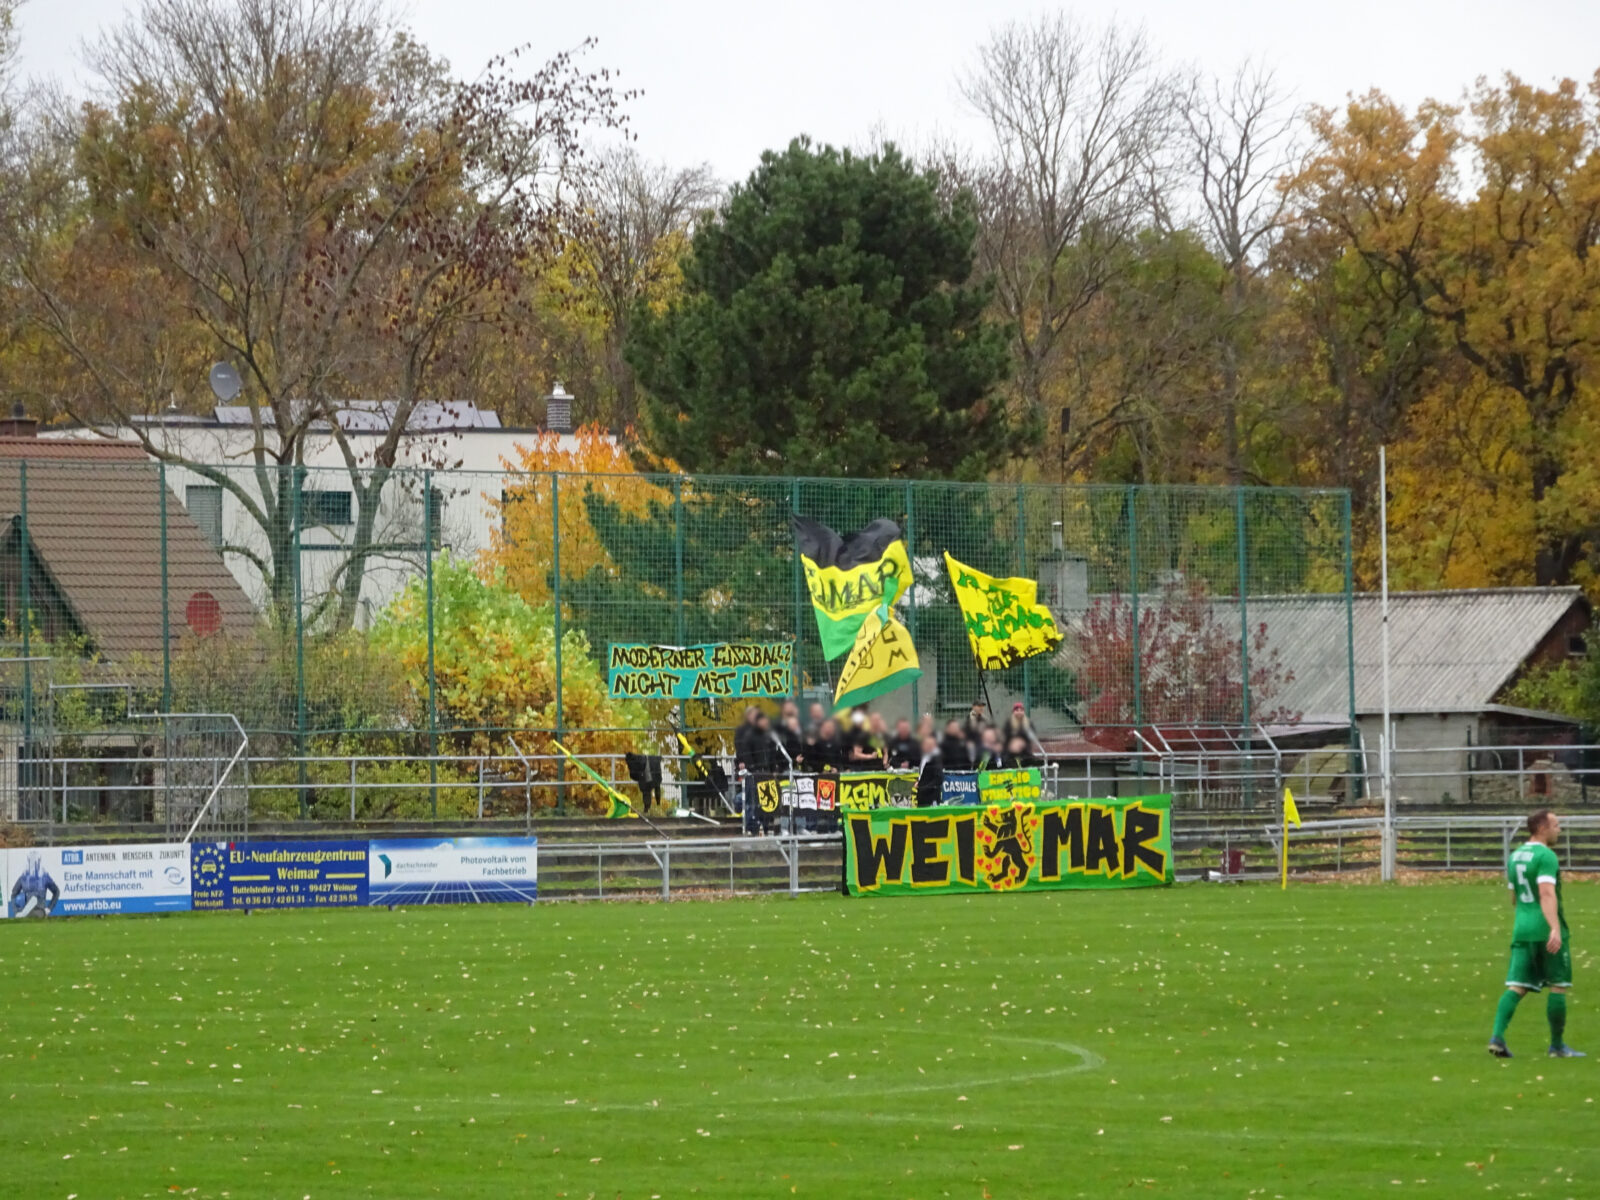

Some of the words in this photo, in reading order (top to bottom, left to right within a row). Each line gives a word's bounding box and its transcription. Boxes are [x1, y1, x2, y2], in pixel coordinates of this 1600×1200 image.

[610, 645, 707, 669] MODERNER
[741, 669, 790, 695] UNS!
[943, 781, 977, 793] CASUALS
[461, 856, 508, 865] Photovoltaik
[510, 856, 526, 864] vom
[64, 872, 82, 881] Eine
[86, 869, 136, 880] Mannschaft
[139, 870, 153, 878] mit
[277, 867, 320, 881] Weimar
[483, 868, 527, 876] Fachbetrieb
[64, 882, 144, 893] Aufstiegschancen.
[309, 883, 331, 892] 99427
[333, 883, 358, 891] Weimar
[1516, 864, 1535, 903] 5
[64, 900, 121, 911] www.atbb.eu
